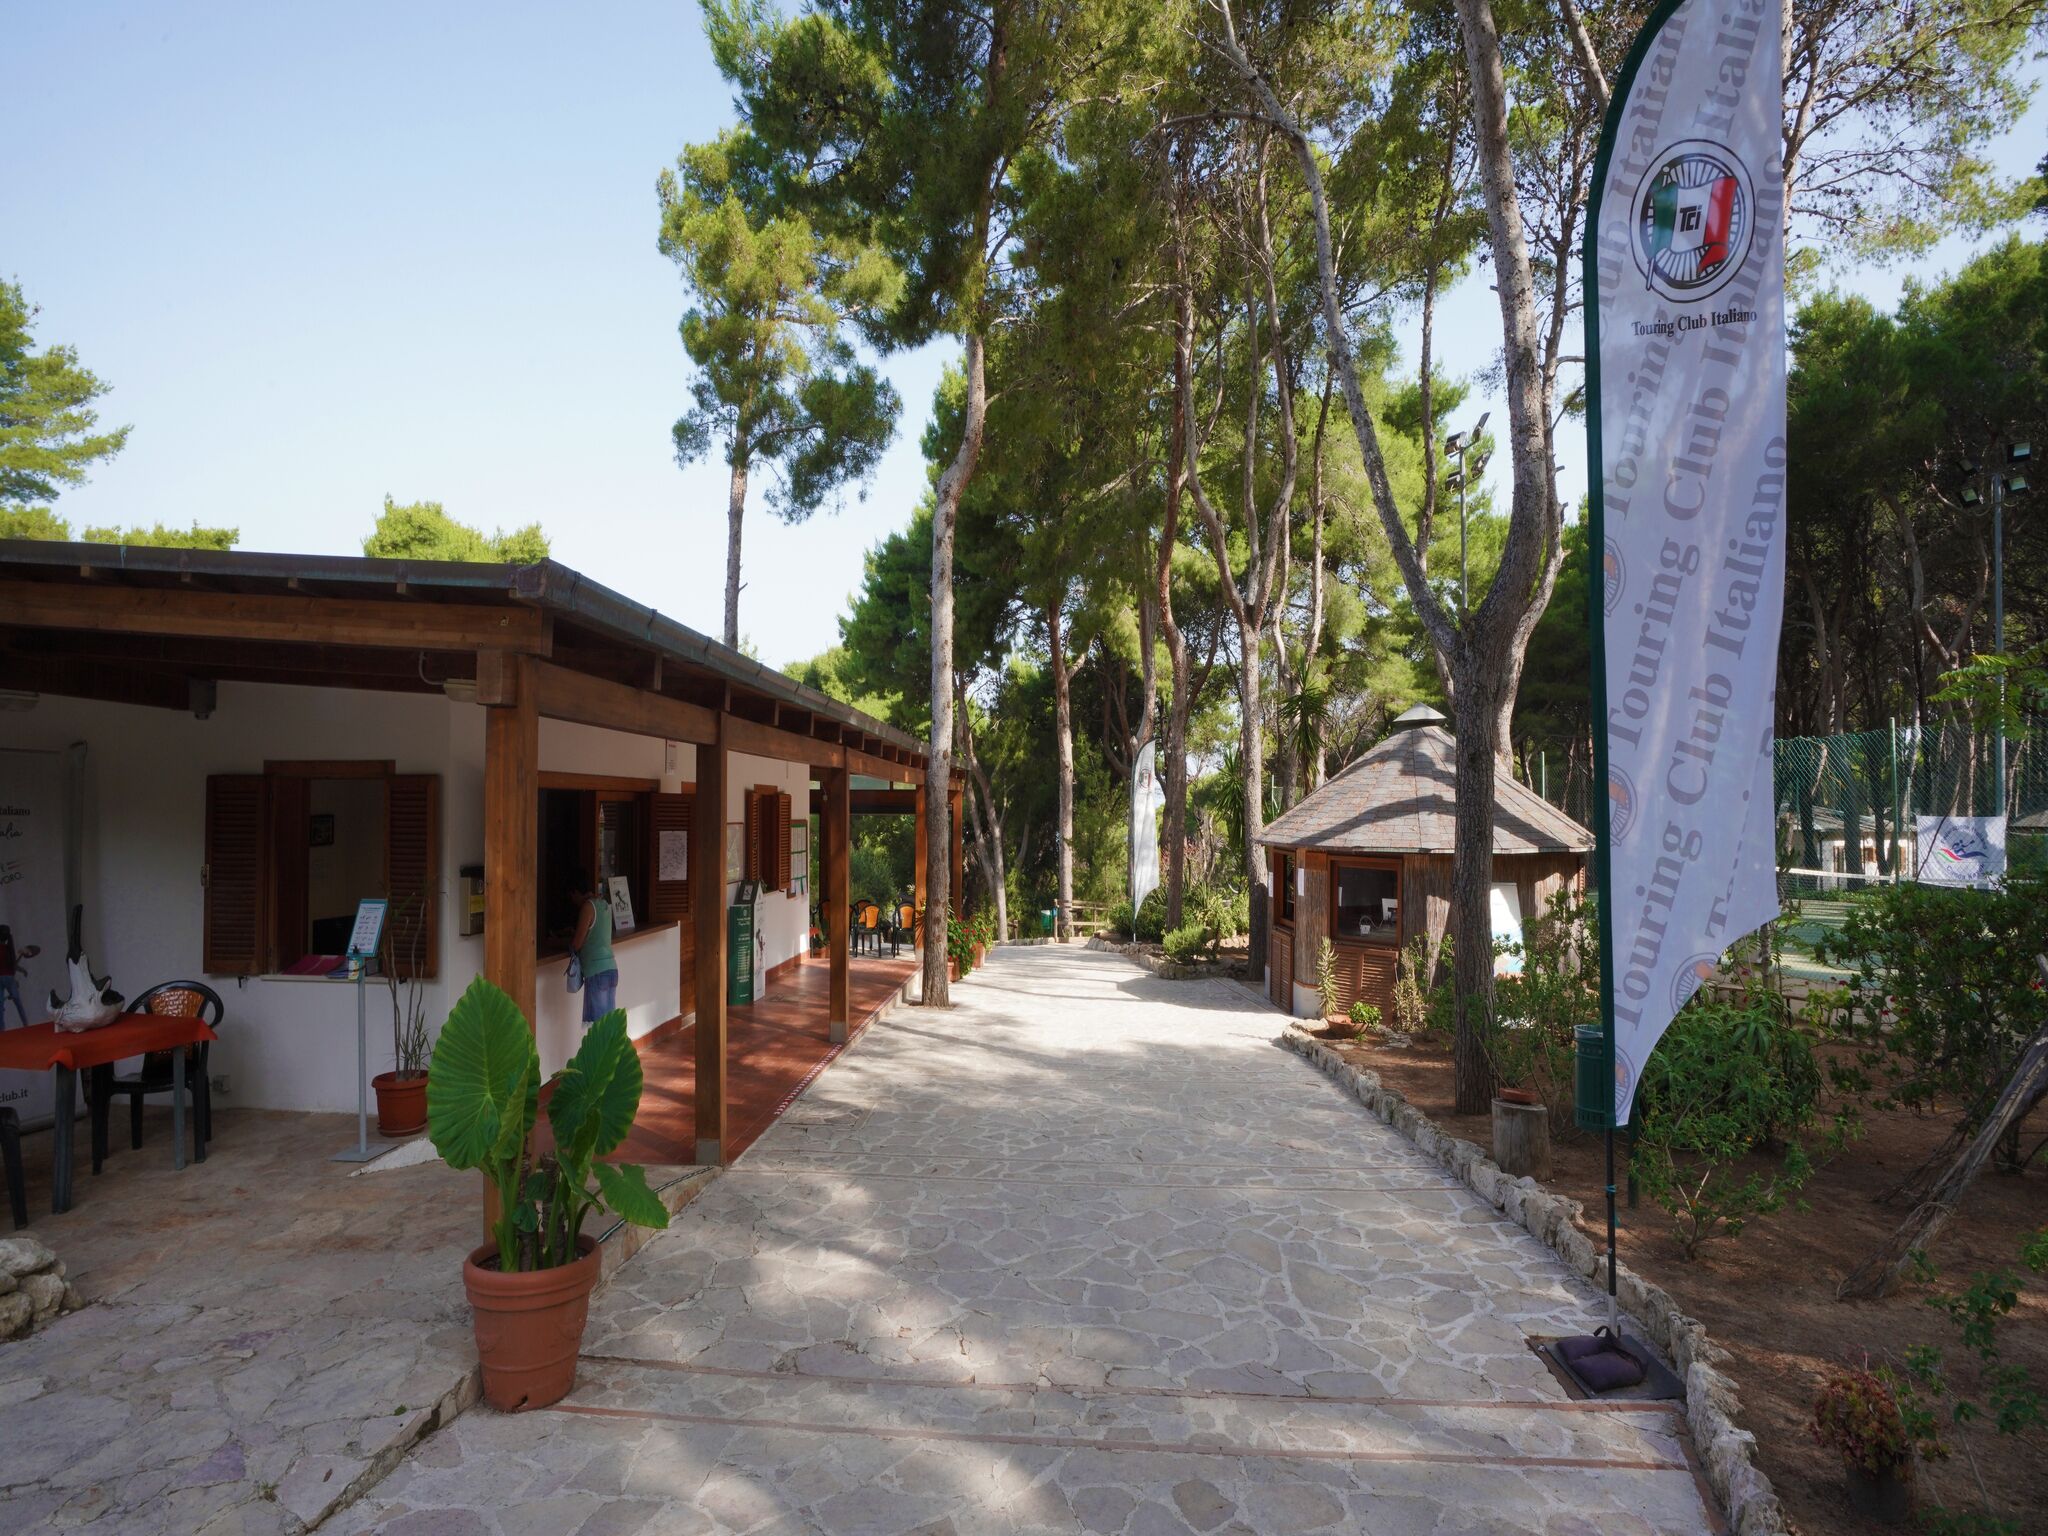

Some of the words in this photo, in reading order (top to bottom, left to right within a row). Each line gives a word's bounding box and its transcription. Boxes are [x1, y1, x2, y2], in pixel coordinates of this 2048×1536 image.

[1609, 0, 1693, 198] Italian
[1631, 319, 1675, 337] Touring
[1677, 314, 1707, 332] Club
[1711, 308, 1758, 327] Italiano
[1608, 537, 1701, 750] Touring
[1663, 387, 1731, 521] Club
[1666, 673, 1733, 806] Club
[1703, 436, 1787, 661] Italiano
